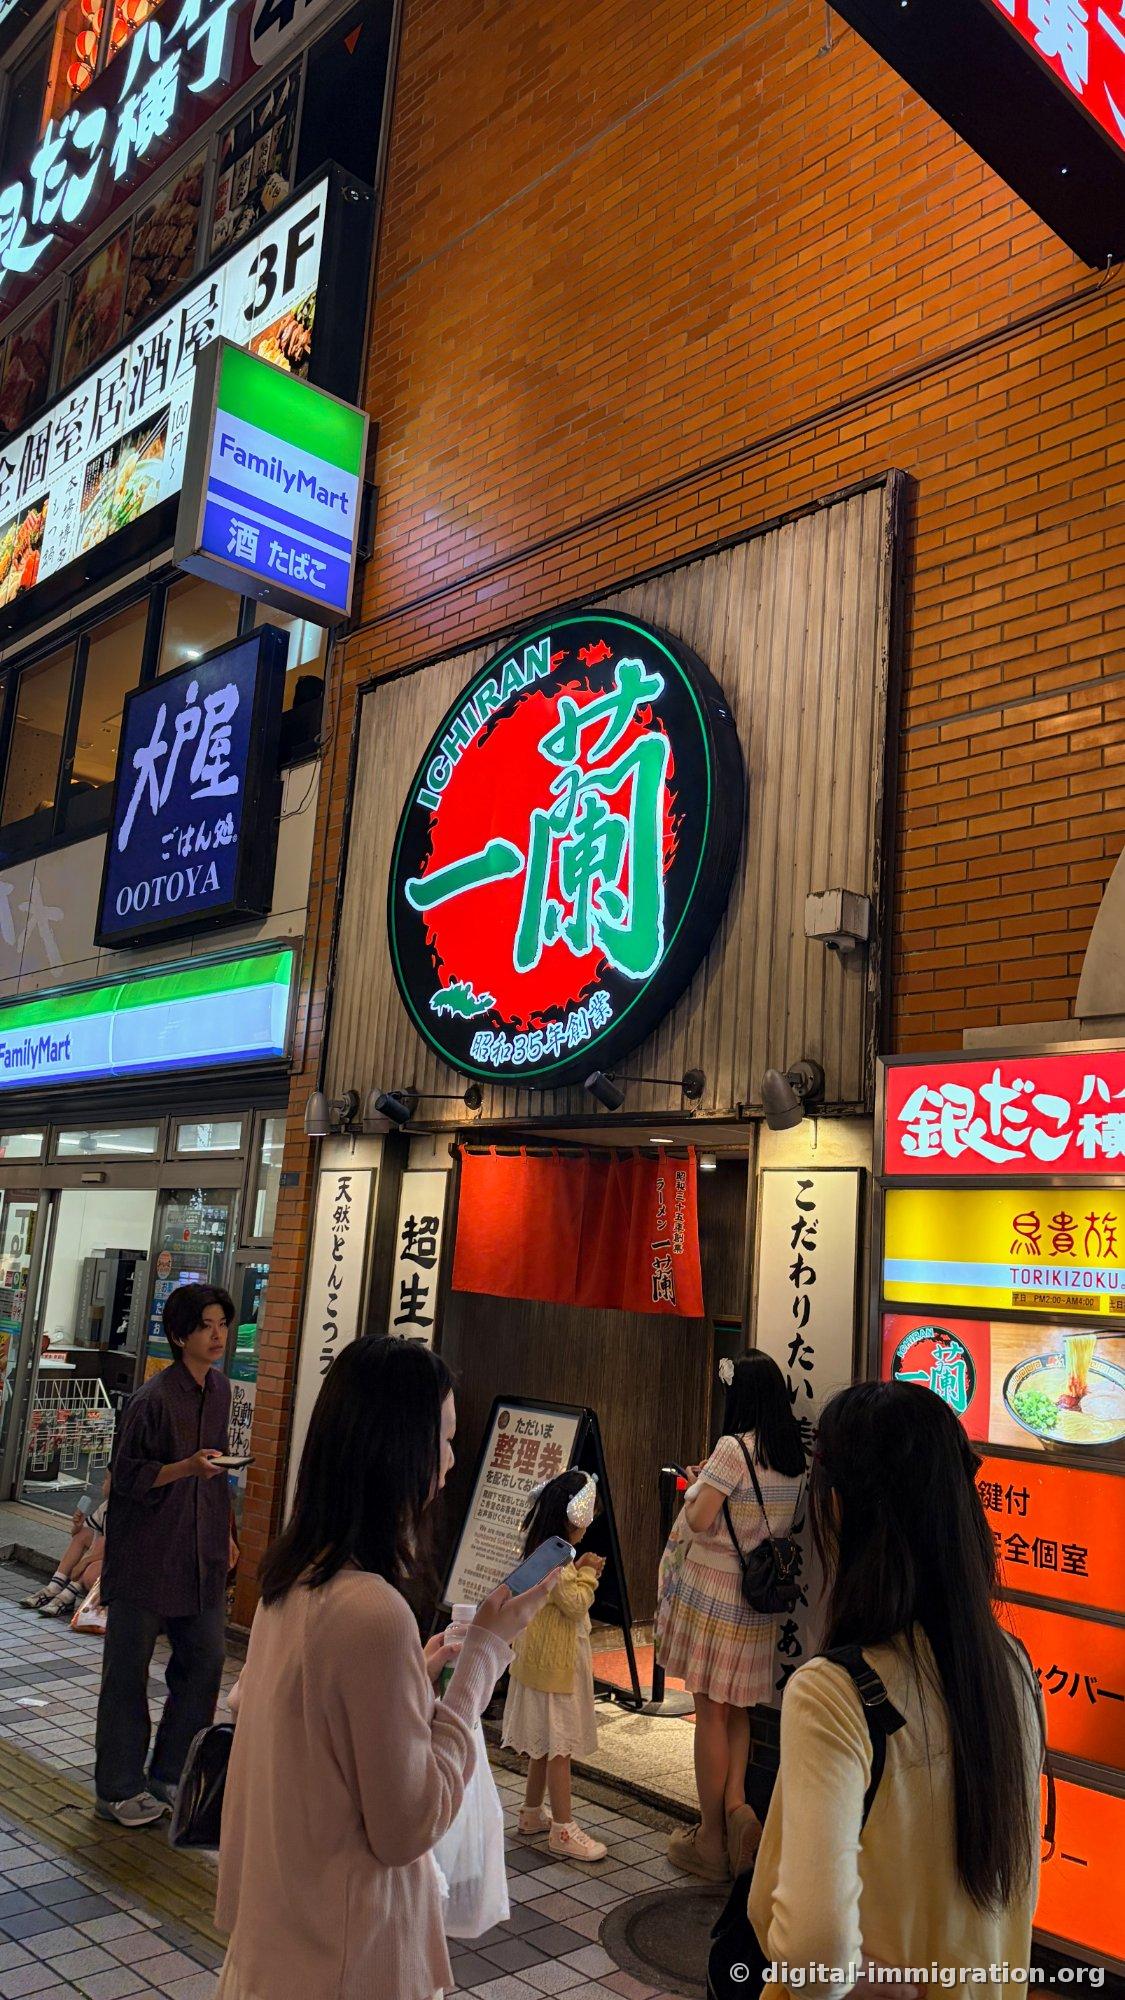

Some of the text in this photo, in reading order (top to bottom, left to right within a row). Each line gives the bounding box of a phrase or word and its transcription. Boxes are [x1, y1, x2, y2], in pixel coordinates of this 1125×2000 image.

[243, 203, 321, 320] 3F
[219, 432, 349, 515] FamilyMart
[226, 516, 328, 590] 酒 たばこ
[416, 637, 552, 811] ICHIRAN
[117, 680, 240, 853] 大戸屋
[404, 658, 670, 980] 一蘭
[116, 860, 221, 916] OOTOYA
[469, 989, 614, 1067] 昭和35年創業
[897, 1067, 1074, 1164] 銀だこ
[655, 1176, 668, 1232] ラーメン
[1009, 1210, 1118, 1259] 鳥貴族
[393, 1214, 440, 1344] 超生
[650, 1238, 677, 1307] 一蘭
[1009, 1267, 1119, 1290] TORIKIZOKU
[1109, 1299, 1125, 1311] 土日
[894, 1341, 967, 1413] 一蘭
[896, 1327, 936, 1358] ICHIRAN
[490, 1432, 563, 1481] 整理券
[515, 1417, 554, 1439] ただいま
[977, 1479, 1031, 1517] 鍵付
